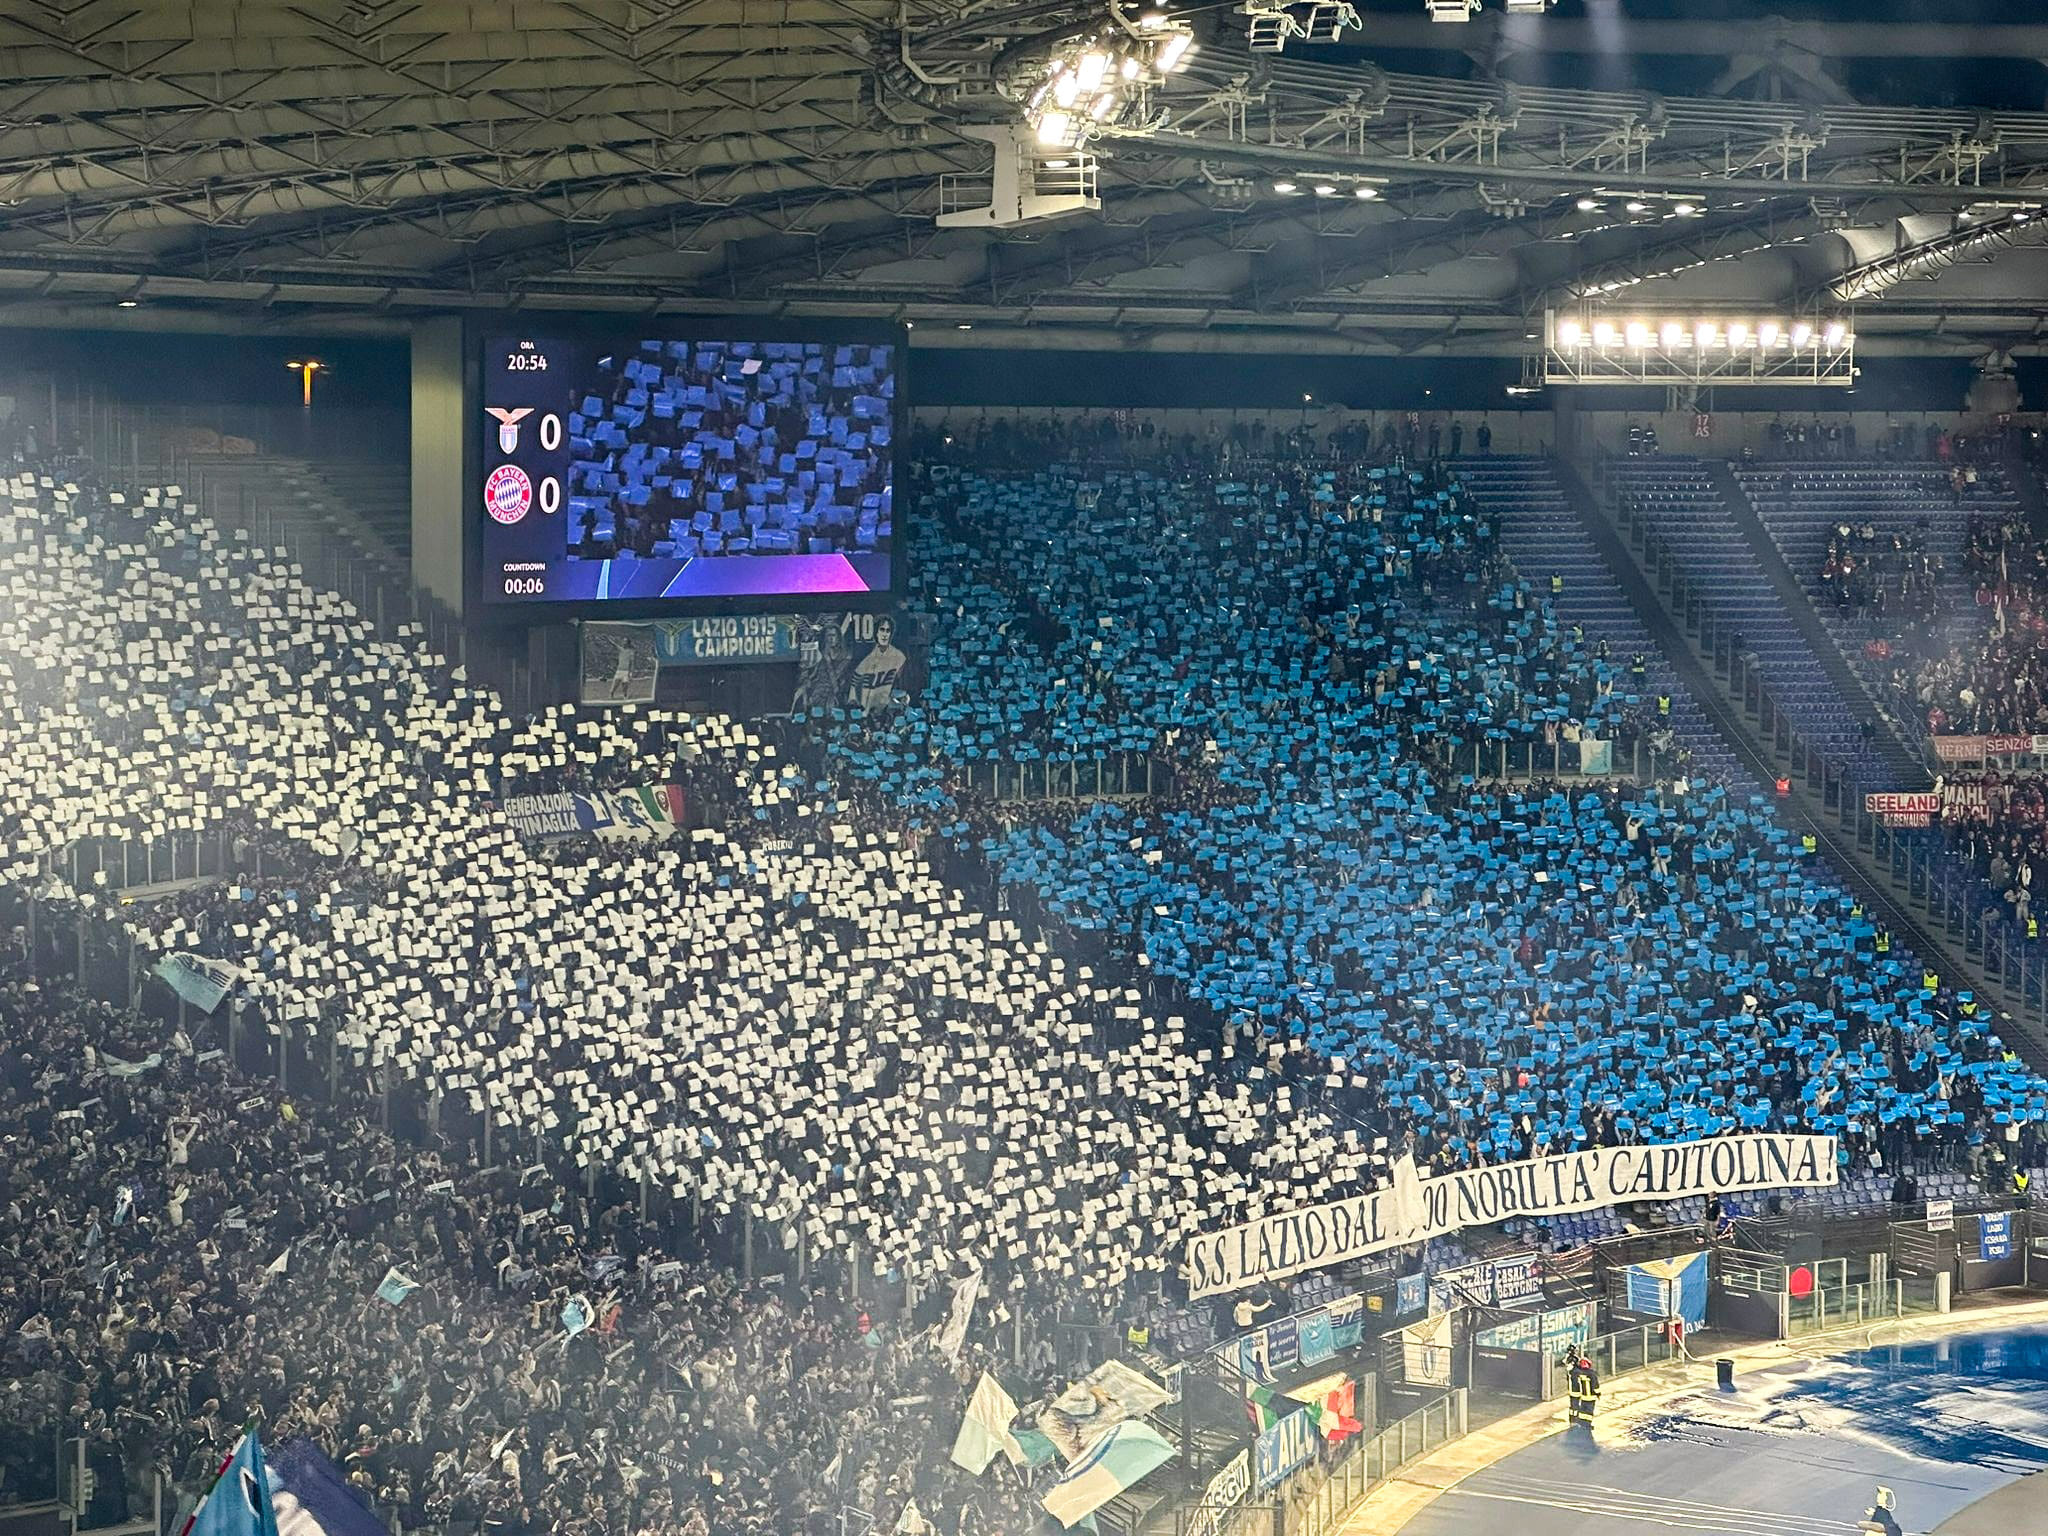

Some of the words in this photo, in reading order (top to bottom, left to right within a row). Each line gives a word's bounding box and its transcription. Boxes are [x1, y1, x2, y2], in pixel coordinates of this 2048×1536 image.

[520, 341, 535, 350] ORA
[507, 354, 548, 371] 20:54
[1696, 415, 1709, 425] 17
[540, 413, 561, 451] 0
[1695, 426, 1710, 437] AS
[497, 468, 529, 490] BAYERN
[539, 476, 560, 514] 0
[503, 563, 546, 571] COUNTDOWN
[504, 578, 544, 594] 00:06
[692, 619, 737, 638] LAZIO
[741, 616, 776, 634] 1915
[694, 637, 774, 657] CAMPIONE
[1986, 738, 2032, 752] SENZIG
[504, 792, 576, 817] GENERAZIONE
[1867, 795, 1938, 811] SEELAND
[1239, 1209, 1327, 1280] LAZIO
[1330, 1195, 1387, 1252] DAL
[1455, 1156, 1599, 1222] NOBILTA'
[1496, 1265, 1525, 1283] CASAL
